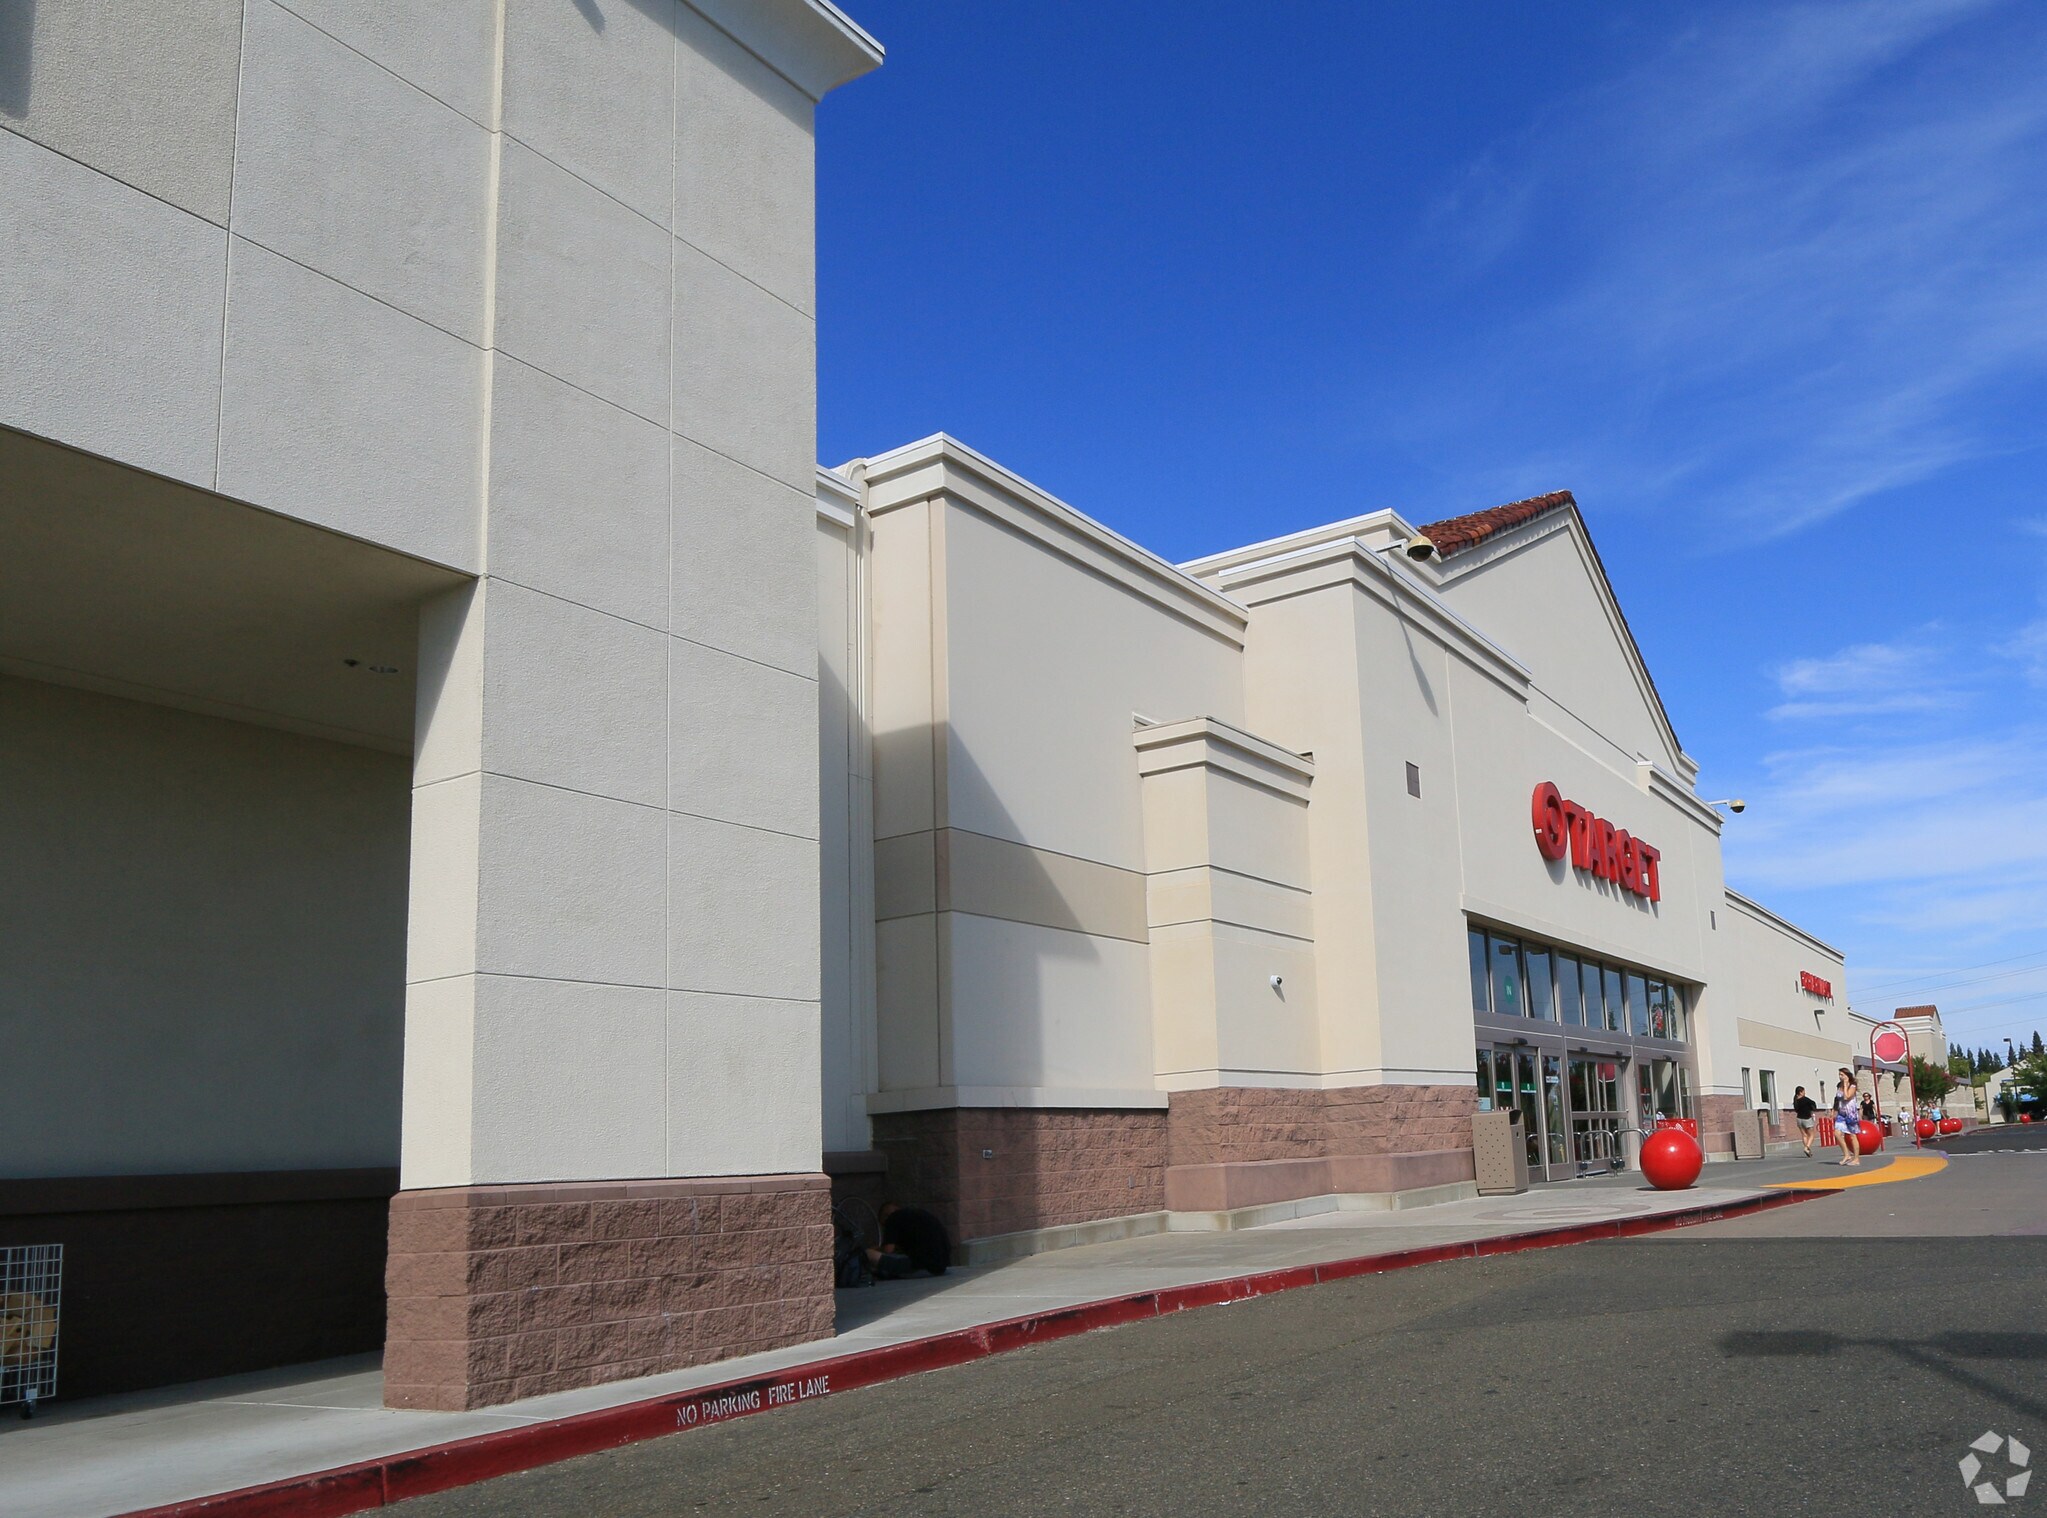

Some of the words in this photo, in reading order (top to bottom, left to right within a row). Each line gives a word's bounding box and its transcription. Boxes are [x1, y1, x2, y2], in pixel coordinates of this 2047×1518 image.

[1562, 799, 1661, 902] TARGET
[677, 1404, 697, 1426] NO
[702, 1391, 760, 1420] PARKING
[768, 1383, 795, 1405] FIRE
[799, 1375, 830, 1399] LANE
